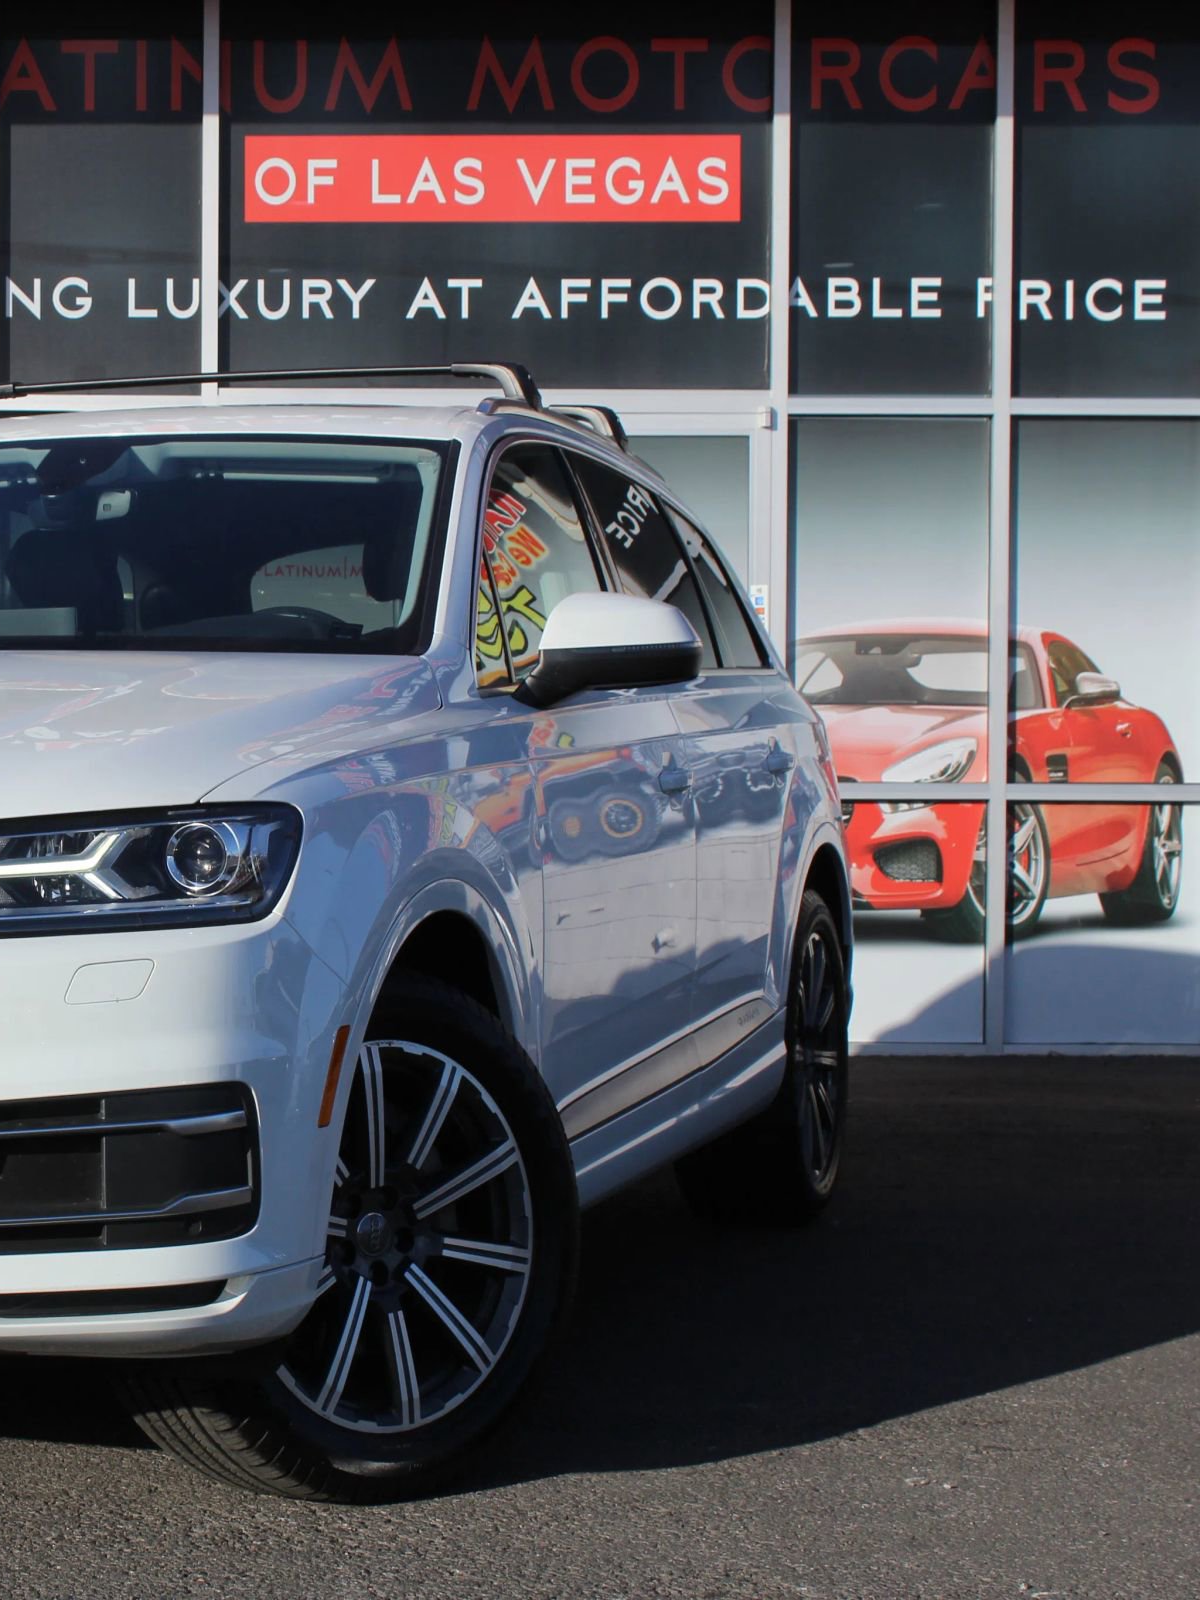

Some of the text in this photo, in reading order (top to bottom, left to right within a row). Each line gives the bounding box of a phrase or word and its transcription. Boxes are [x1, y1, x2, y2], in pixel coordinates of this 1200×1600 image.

[466, 35, 1161, 113] MOTORCARS
[254, 156, 730, 206] OF LAS VEGAS
[128, 276, 376, 320] LUXURY
[405, 277, 483, 319] AT
[511, 276, 942, 320] AFFORDABLE
[256, 564, 339, 577] LATINUM
